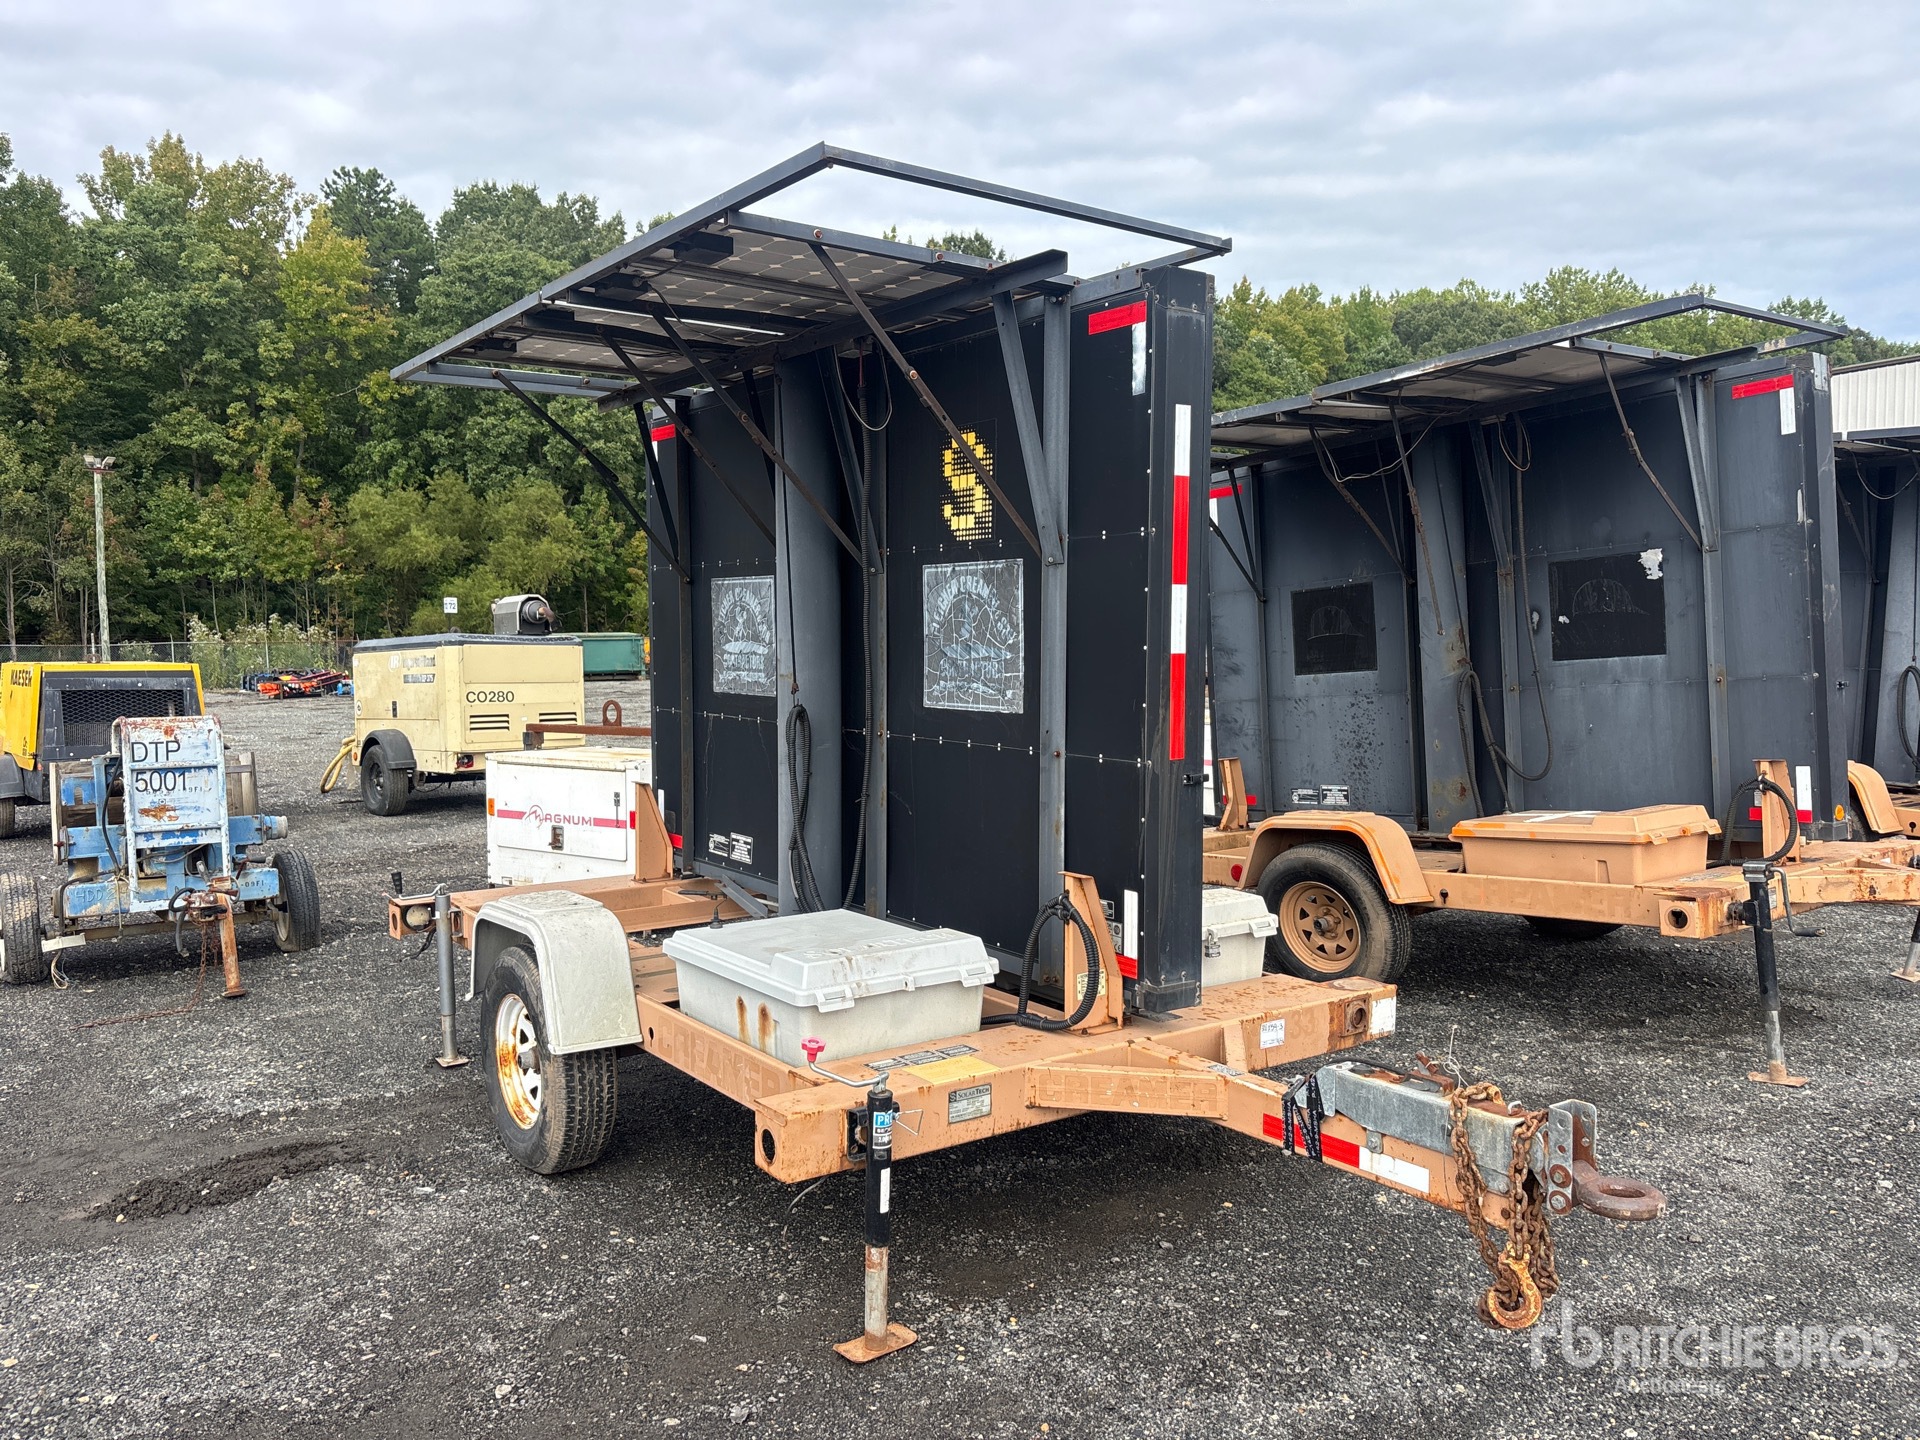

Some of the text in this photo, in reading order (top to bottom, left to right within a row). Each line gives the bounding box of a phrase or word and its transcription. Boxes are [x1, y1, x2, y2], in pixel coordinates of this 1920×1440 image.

[466, 690, 515, 703] CO280
[131, 740, 181, 763] DTP
[135, 770, 187, 793] 5001
